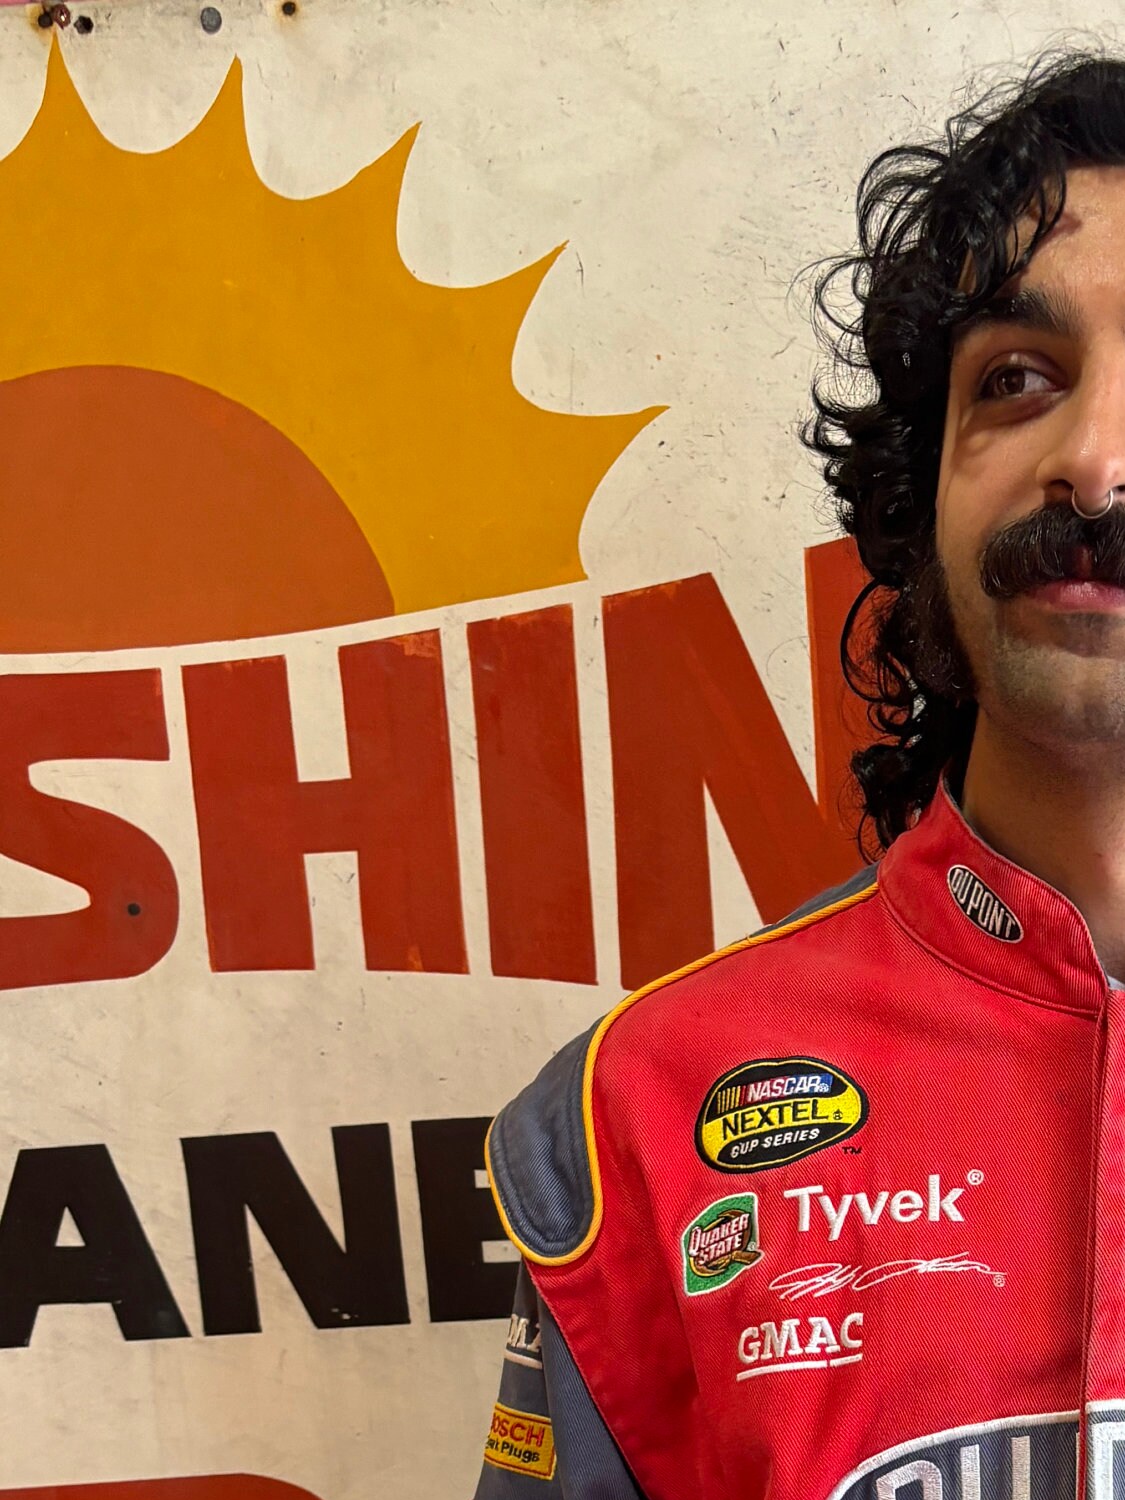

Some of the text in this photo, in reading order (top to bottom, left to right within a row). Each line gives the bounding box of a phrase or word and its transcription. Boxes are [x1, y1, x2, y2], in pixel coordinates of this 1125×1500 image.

[747, 1076, 822, 1102] NASCAR
[722, 1099, 829, 1140] NEXTEL
[730, 1128, 820, 1159] CUP SERIES
[689, 1213, 750, 1256] QUAKER
[699, 1232, 743, 1265] STATE
[736, 1312, 864, 1364] GMAC
[491, 1412, 546, 1448] OSCH
[501, 1441, 540, 1464] Plugs
